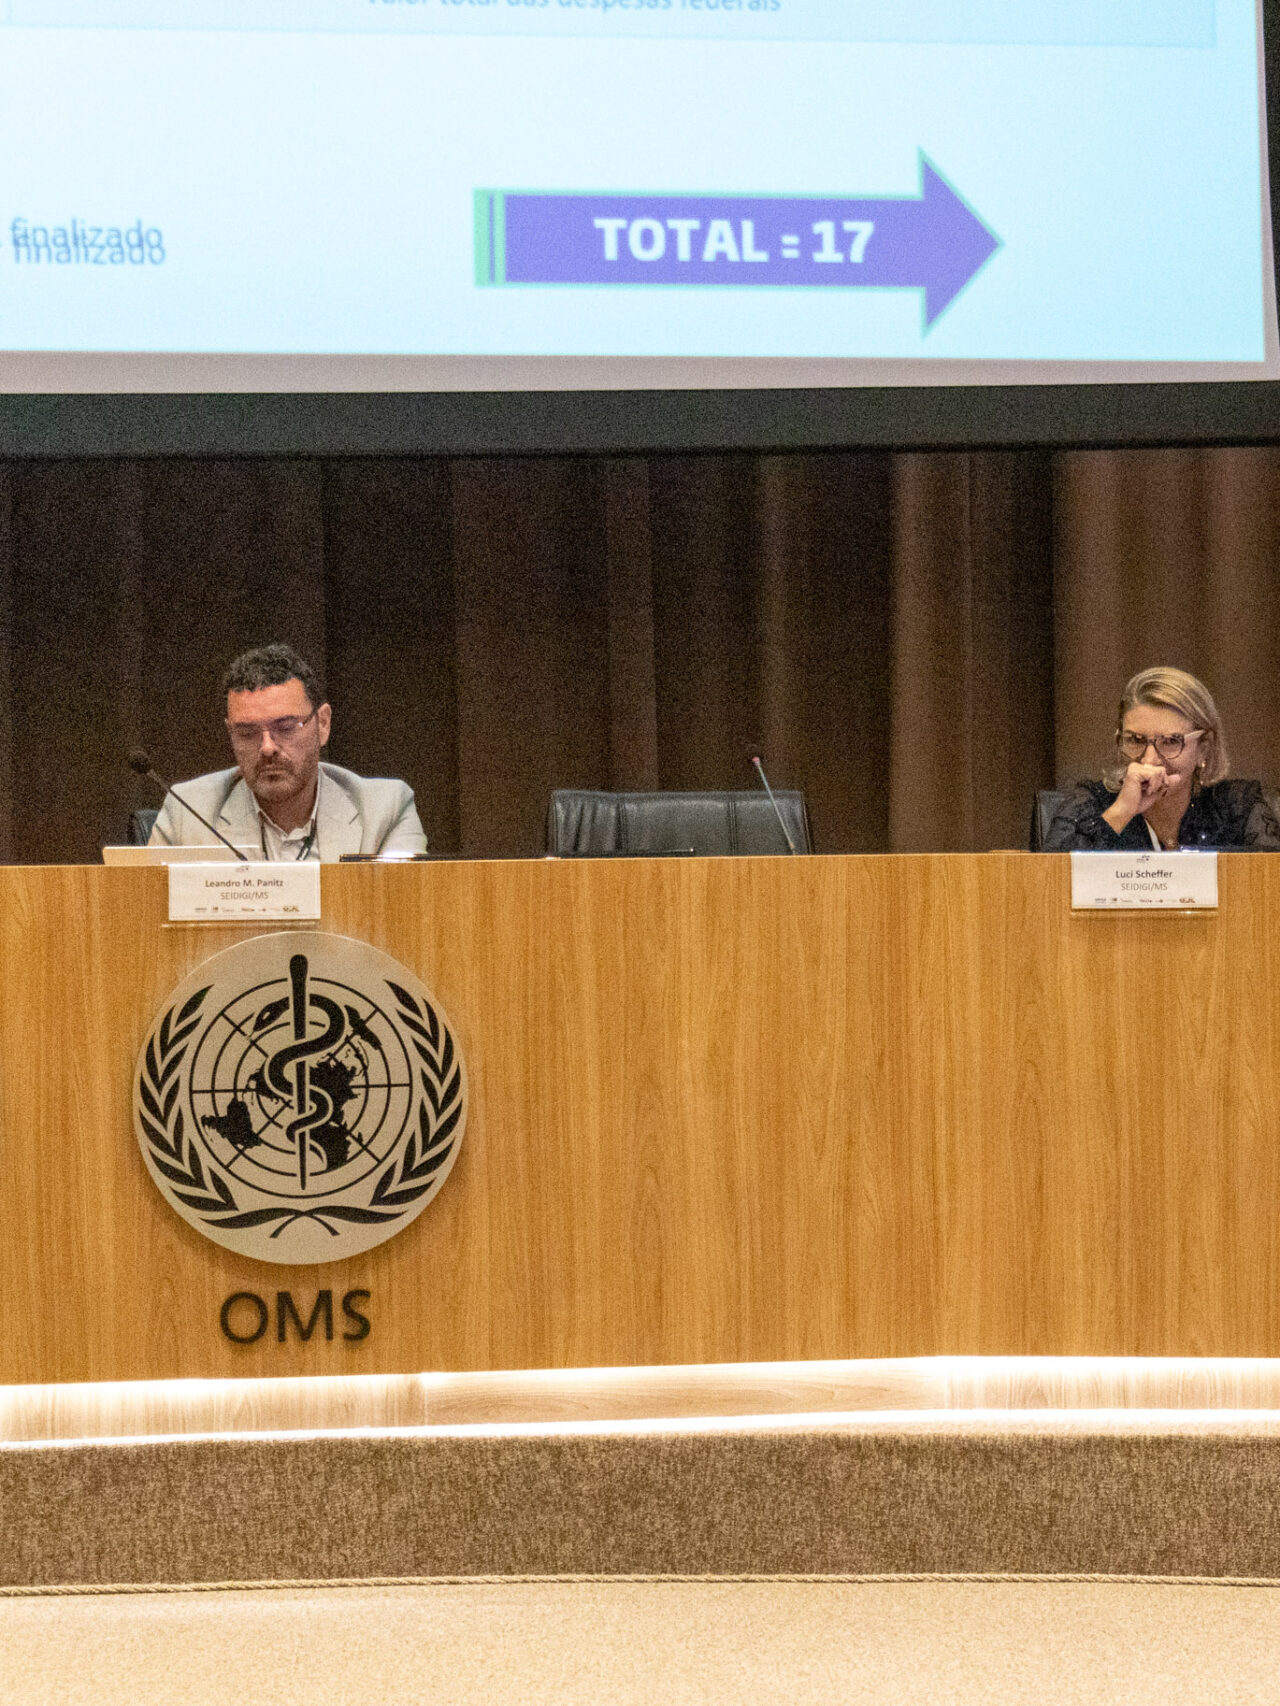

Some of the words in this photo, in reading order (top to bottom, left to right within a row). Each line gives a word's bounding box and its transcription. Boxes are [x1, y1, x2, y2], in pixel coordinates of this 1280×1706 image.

[593, 217, 770, 263] TOTAL
[781, 235, 800, 259] =
[811, 220, 875, 264] 17
[1115, 870, 1134, 879] Luci
[1135, 869, 1173, 879] Scheffer
[205, 879, 241, 888] Leandro
[243, 879, 255, 888] M.
[257, 878, 284, 887] Panitz
[1121, 882, 1168, 892] SEIDIGI/MS
[220, 891, 269, 901] SEIDIGI/MS
[220, 1289, 372, 1344] OMS
